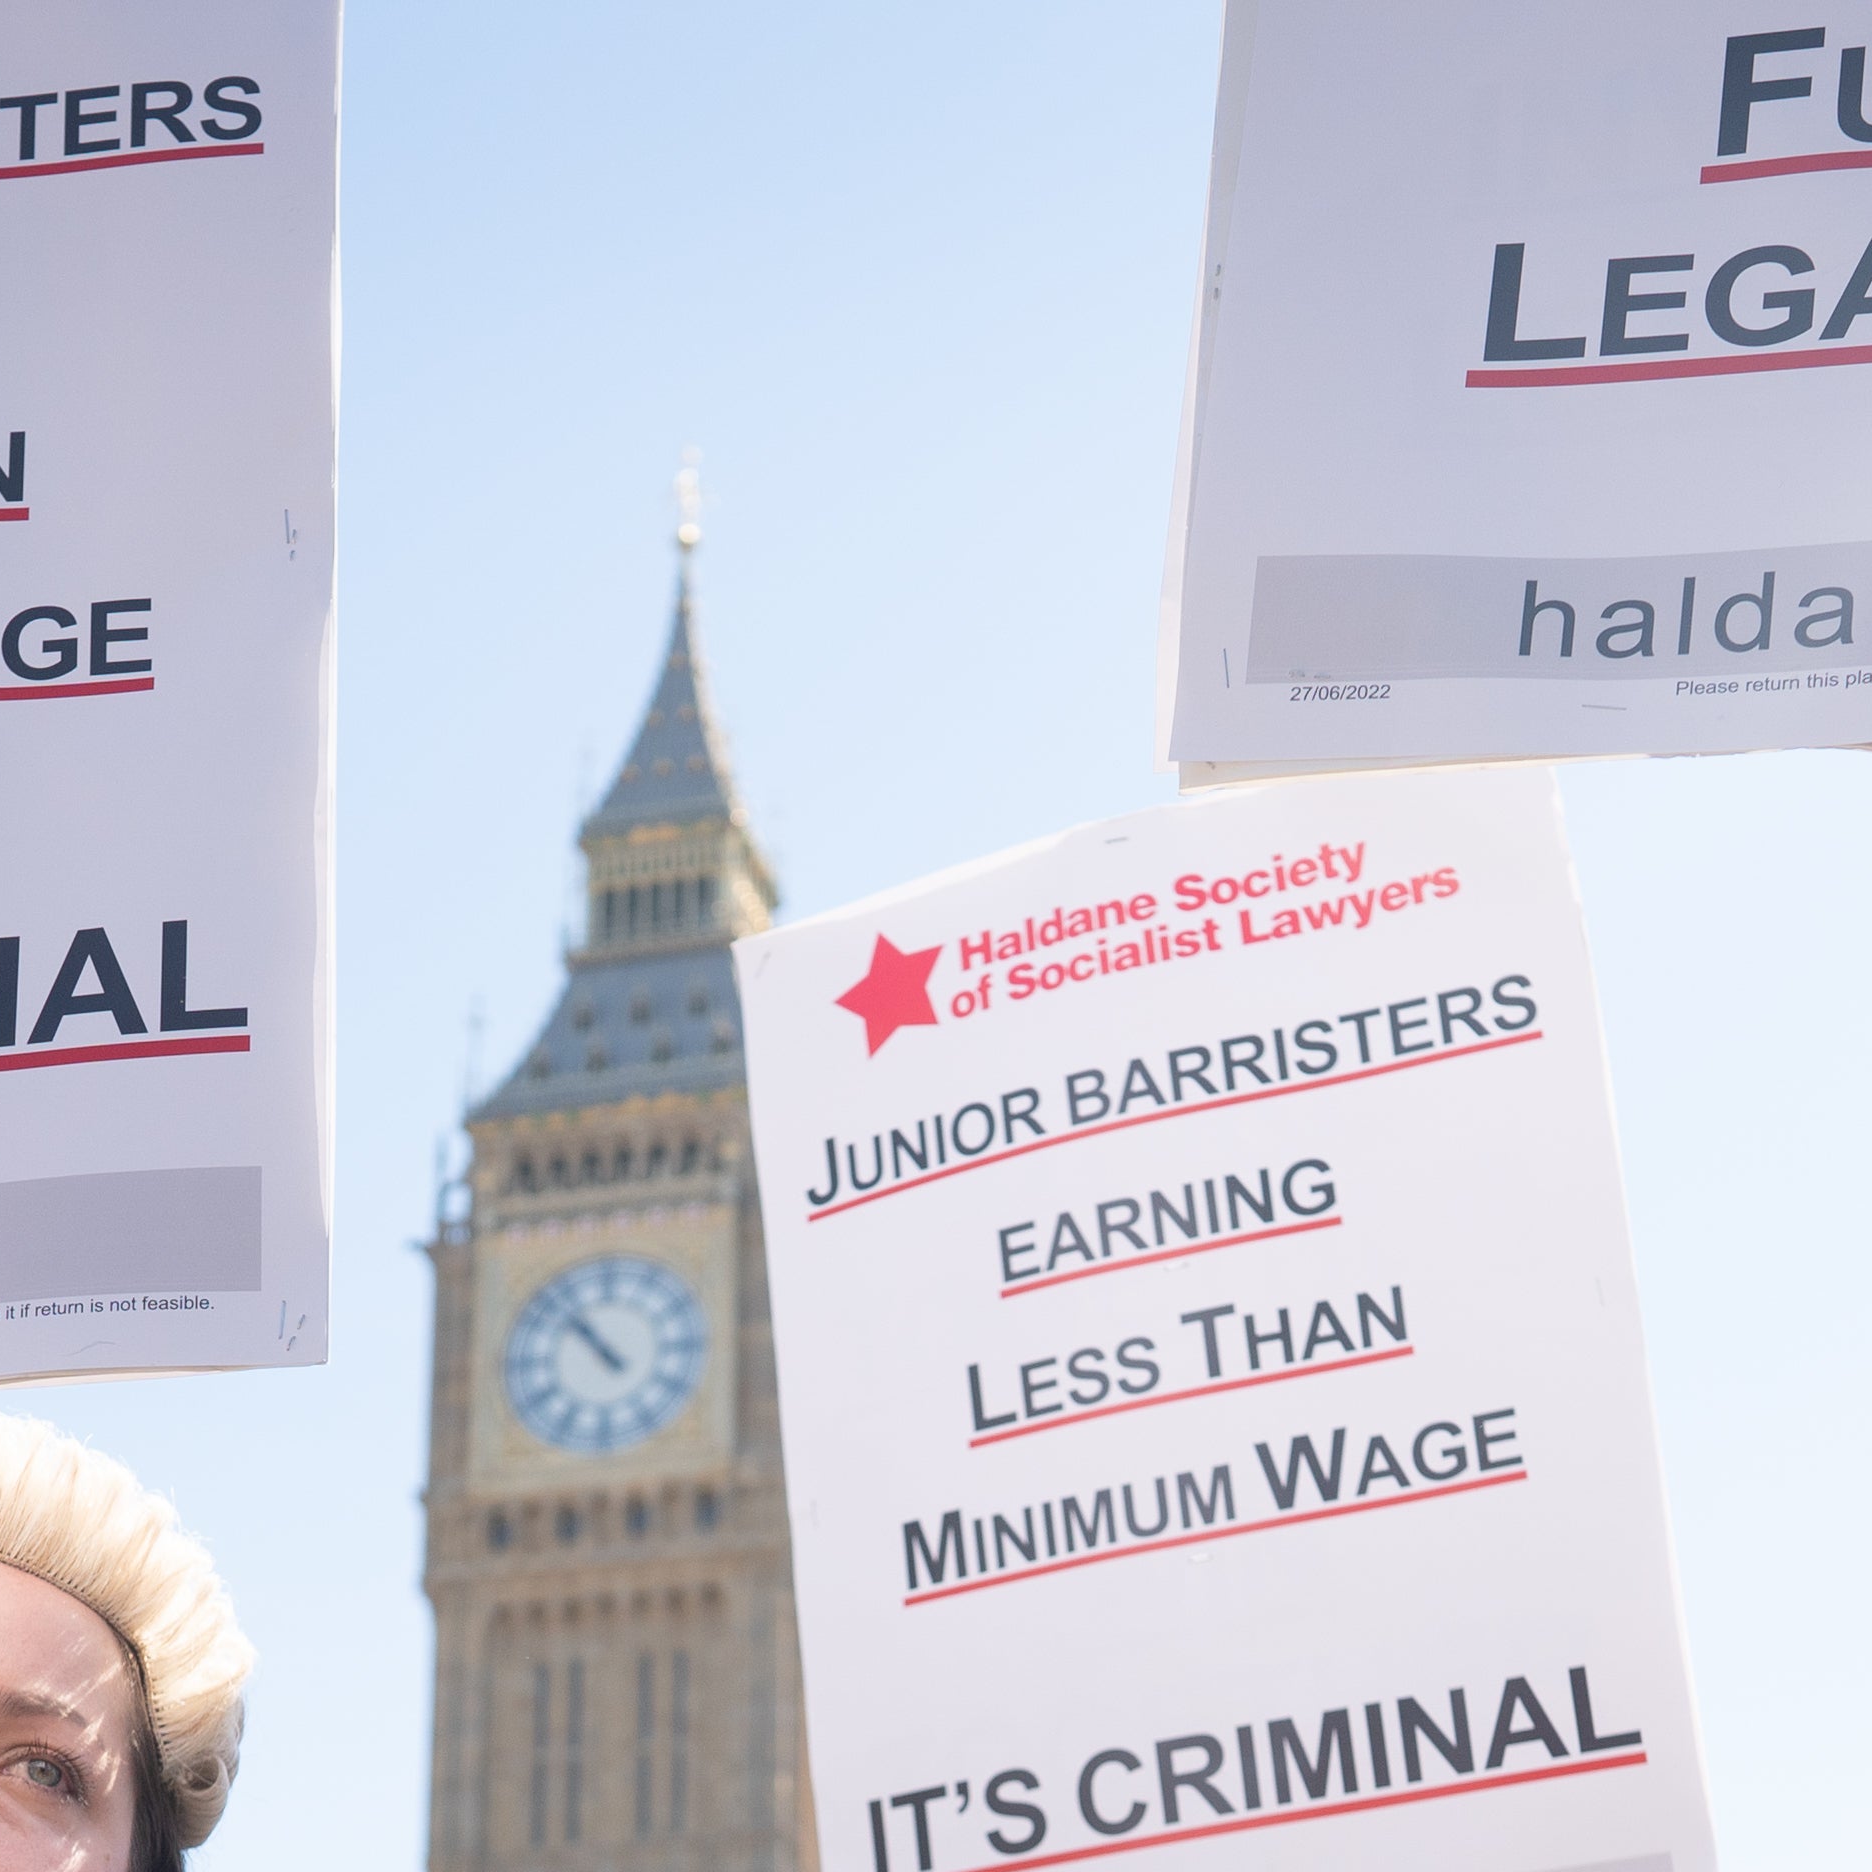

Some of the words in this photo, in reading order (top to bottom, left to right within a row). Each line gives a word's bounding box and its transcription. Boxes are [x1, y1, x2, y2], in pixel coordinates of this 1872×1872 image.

[1290, 684, 1391, 701] 27/06/2022
[1675, 679, 1739, 696] Please
[1745, 676, 1800, 693] return
[1806, 672, 1839, 688] this
[949, 977, 994, 1019] of
[1006, 920, 1223, 1002] Socialist
[1239, 867, 1461, 946] Lawyers
[958, 889, 1157, 972] Haldane
[1172, 841, 1368, 914] Society
[808, 1087, 1044, 1207] JUNIOR
[1066, 975, 1538, 1127] BARRISTERS
[998, 1159, 1337, 1283] EARNING
[5, 1305, 15, 1321] it
[20, 1303, 31, 1320] if
[34, 1301, 85, 1317] return
[89, 1299, 103, 1314] is
[109, 1297, 137, 1313] not
[141, 1294, 215, 1311] feasible.
[967, 1336, 1161, 1431] LESS
[1181, 1287, 1410, 1380] THAN
[903, 1465, 1237, 1590] MINIMUM
[1255, 1409, 1525, 1511] WAGE
[1077, 1666, 1643, 1837] CRIMINAL
